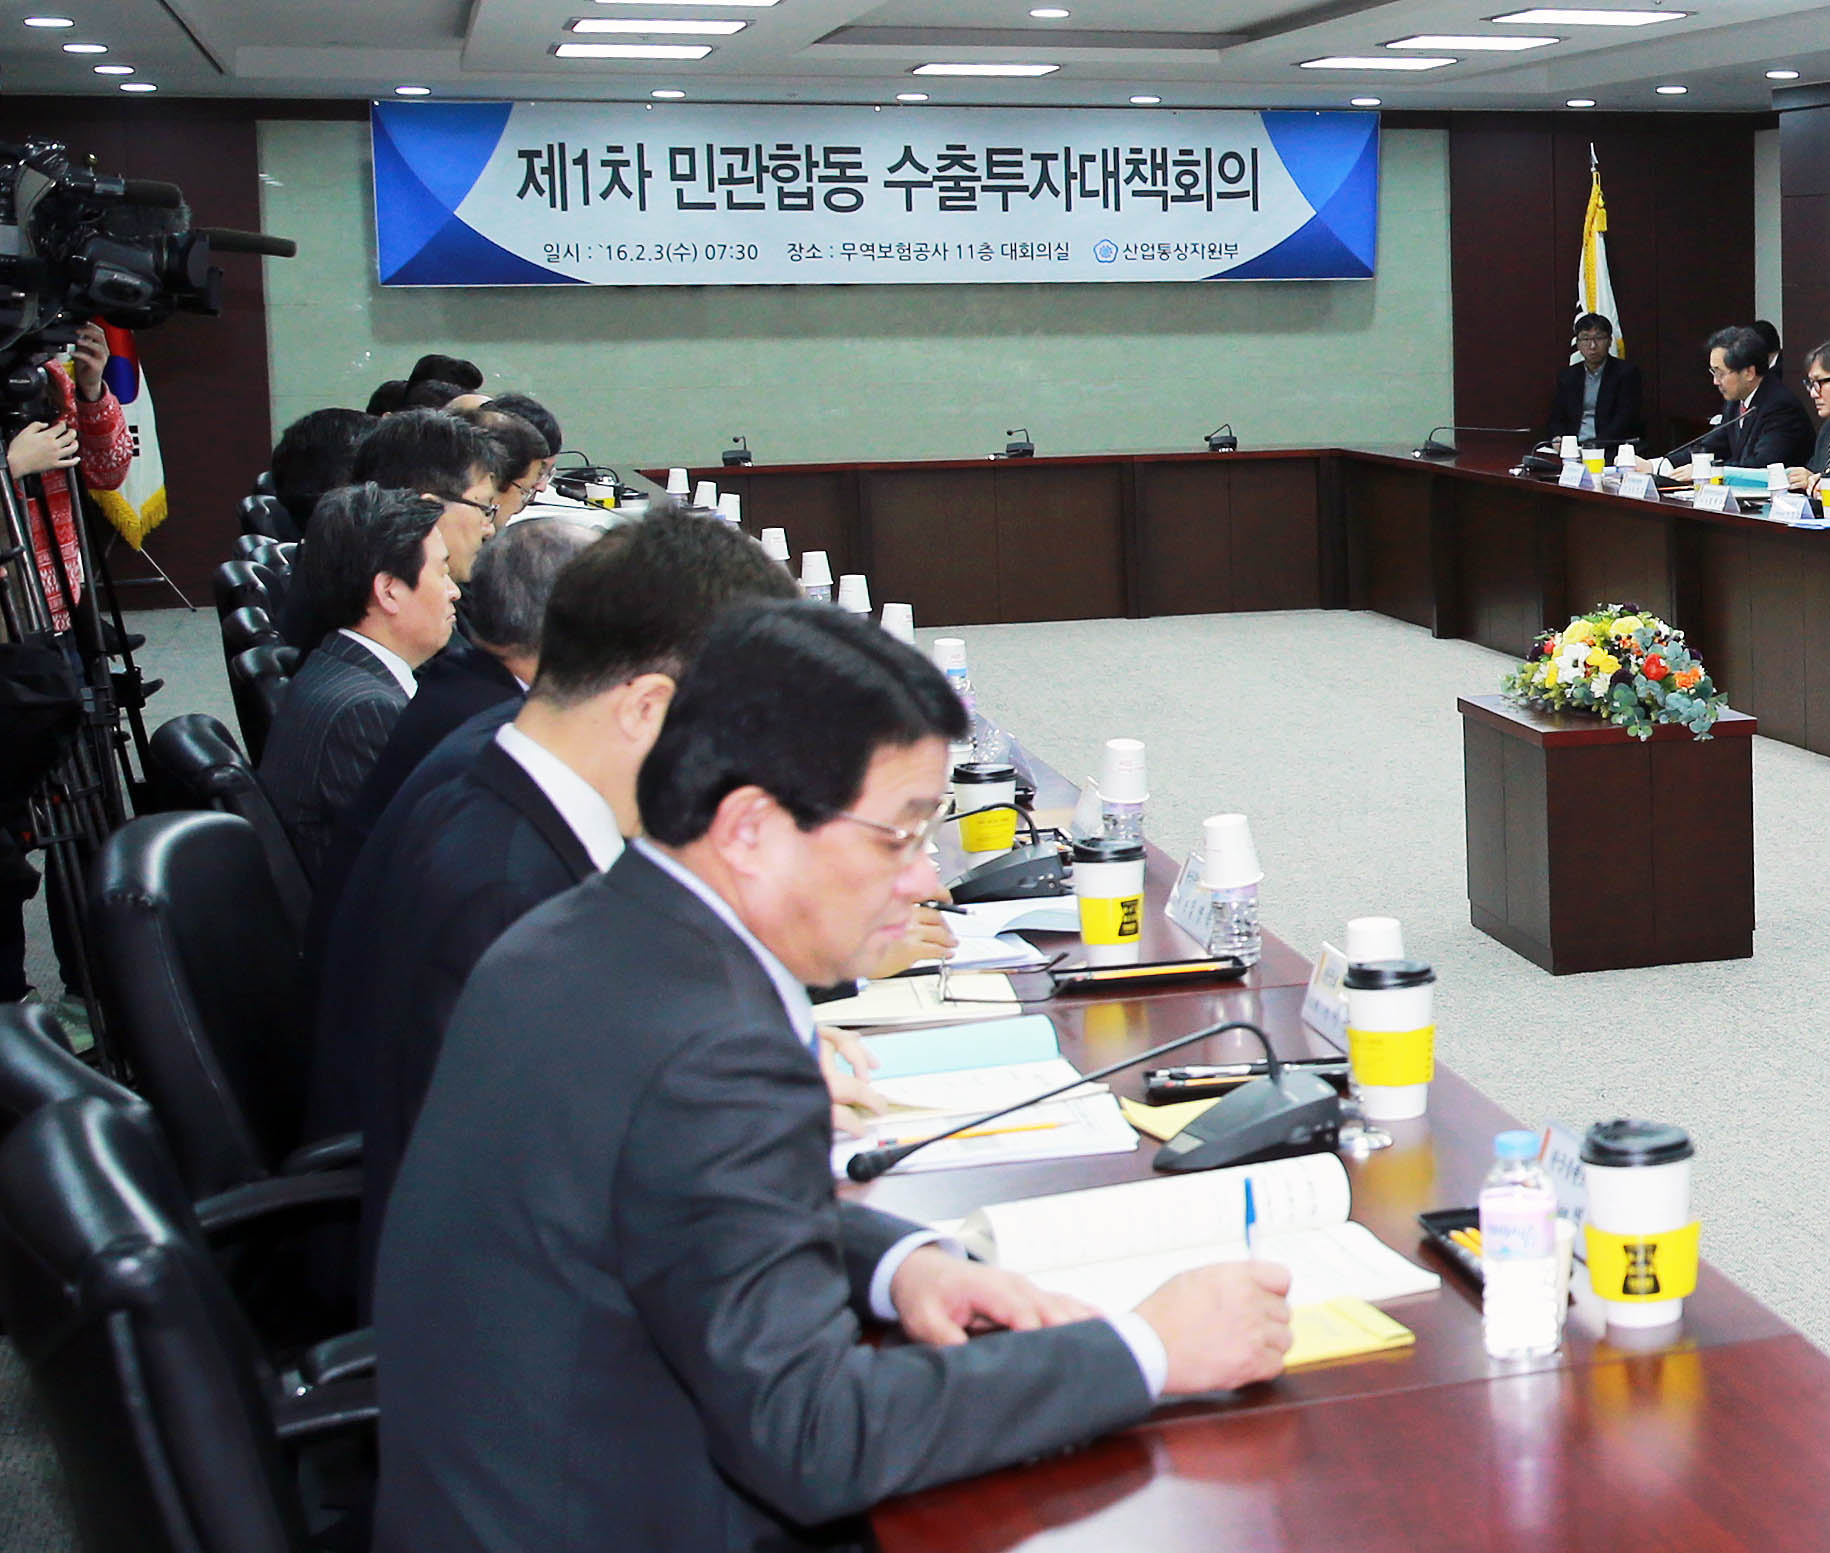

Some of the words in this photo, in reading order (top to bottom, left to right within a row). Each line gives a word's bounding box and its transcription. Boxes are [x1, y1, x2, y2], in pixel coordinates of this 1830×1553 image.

[516, 142, 653, 212] 제1차
[668, 143, 869, 213] 민관합동
[883, 143, 1259, 213] 수출투자대책회의
[544, 242, 580, 263] 일시
[704, 243, 758, 261] 07:30
[787, 242, 824, 262] 장소
[839, 242, 949, 262] 무역보험공사
[956, 242, 995, 262] 11층
[1000, 241, 1070, 262] 대회의실
[1122, 241, 1240, 261] 산업통상자원부
